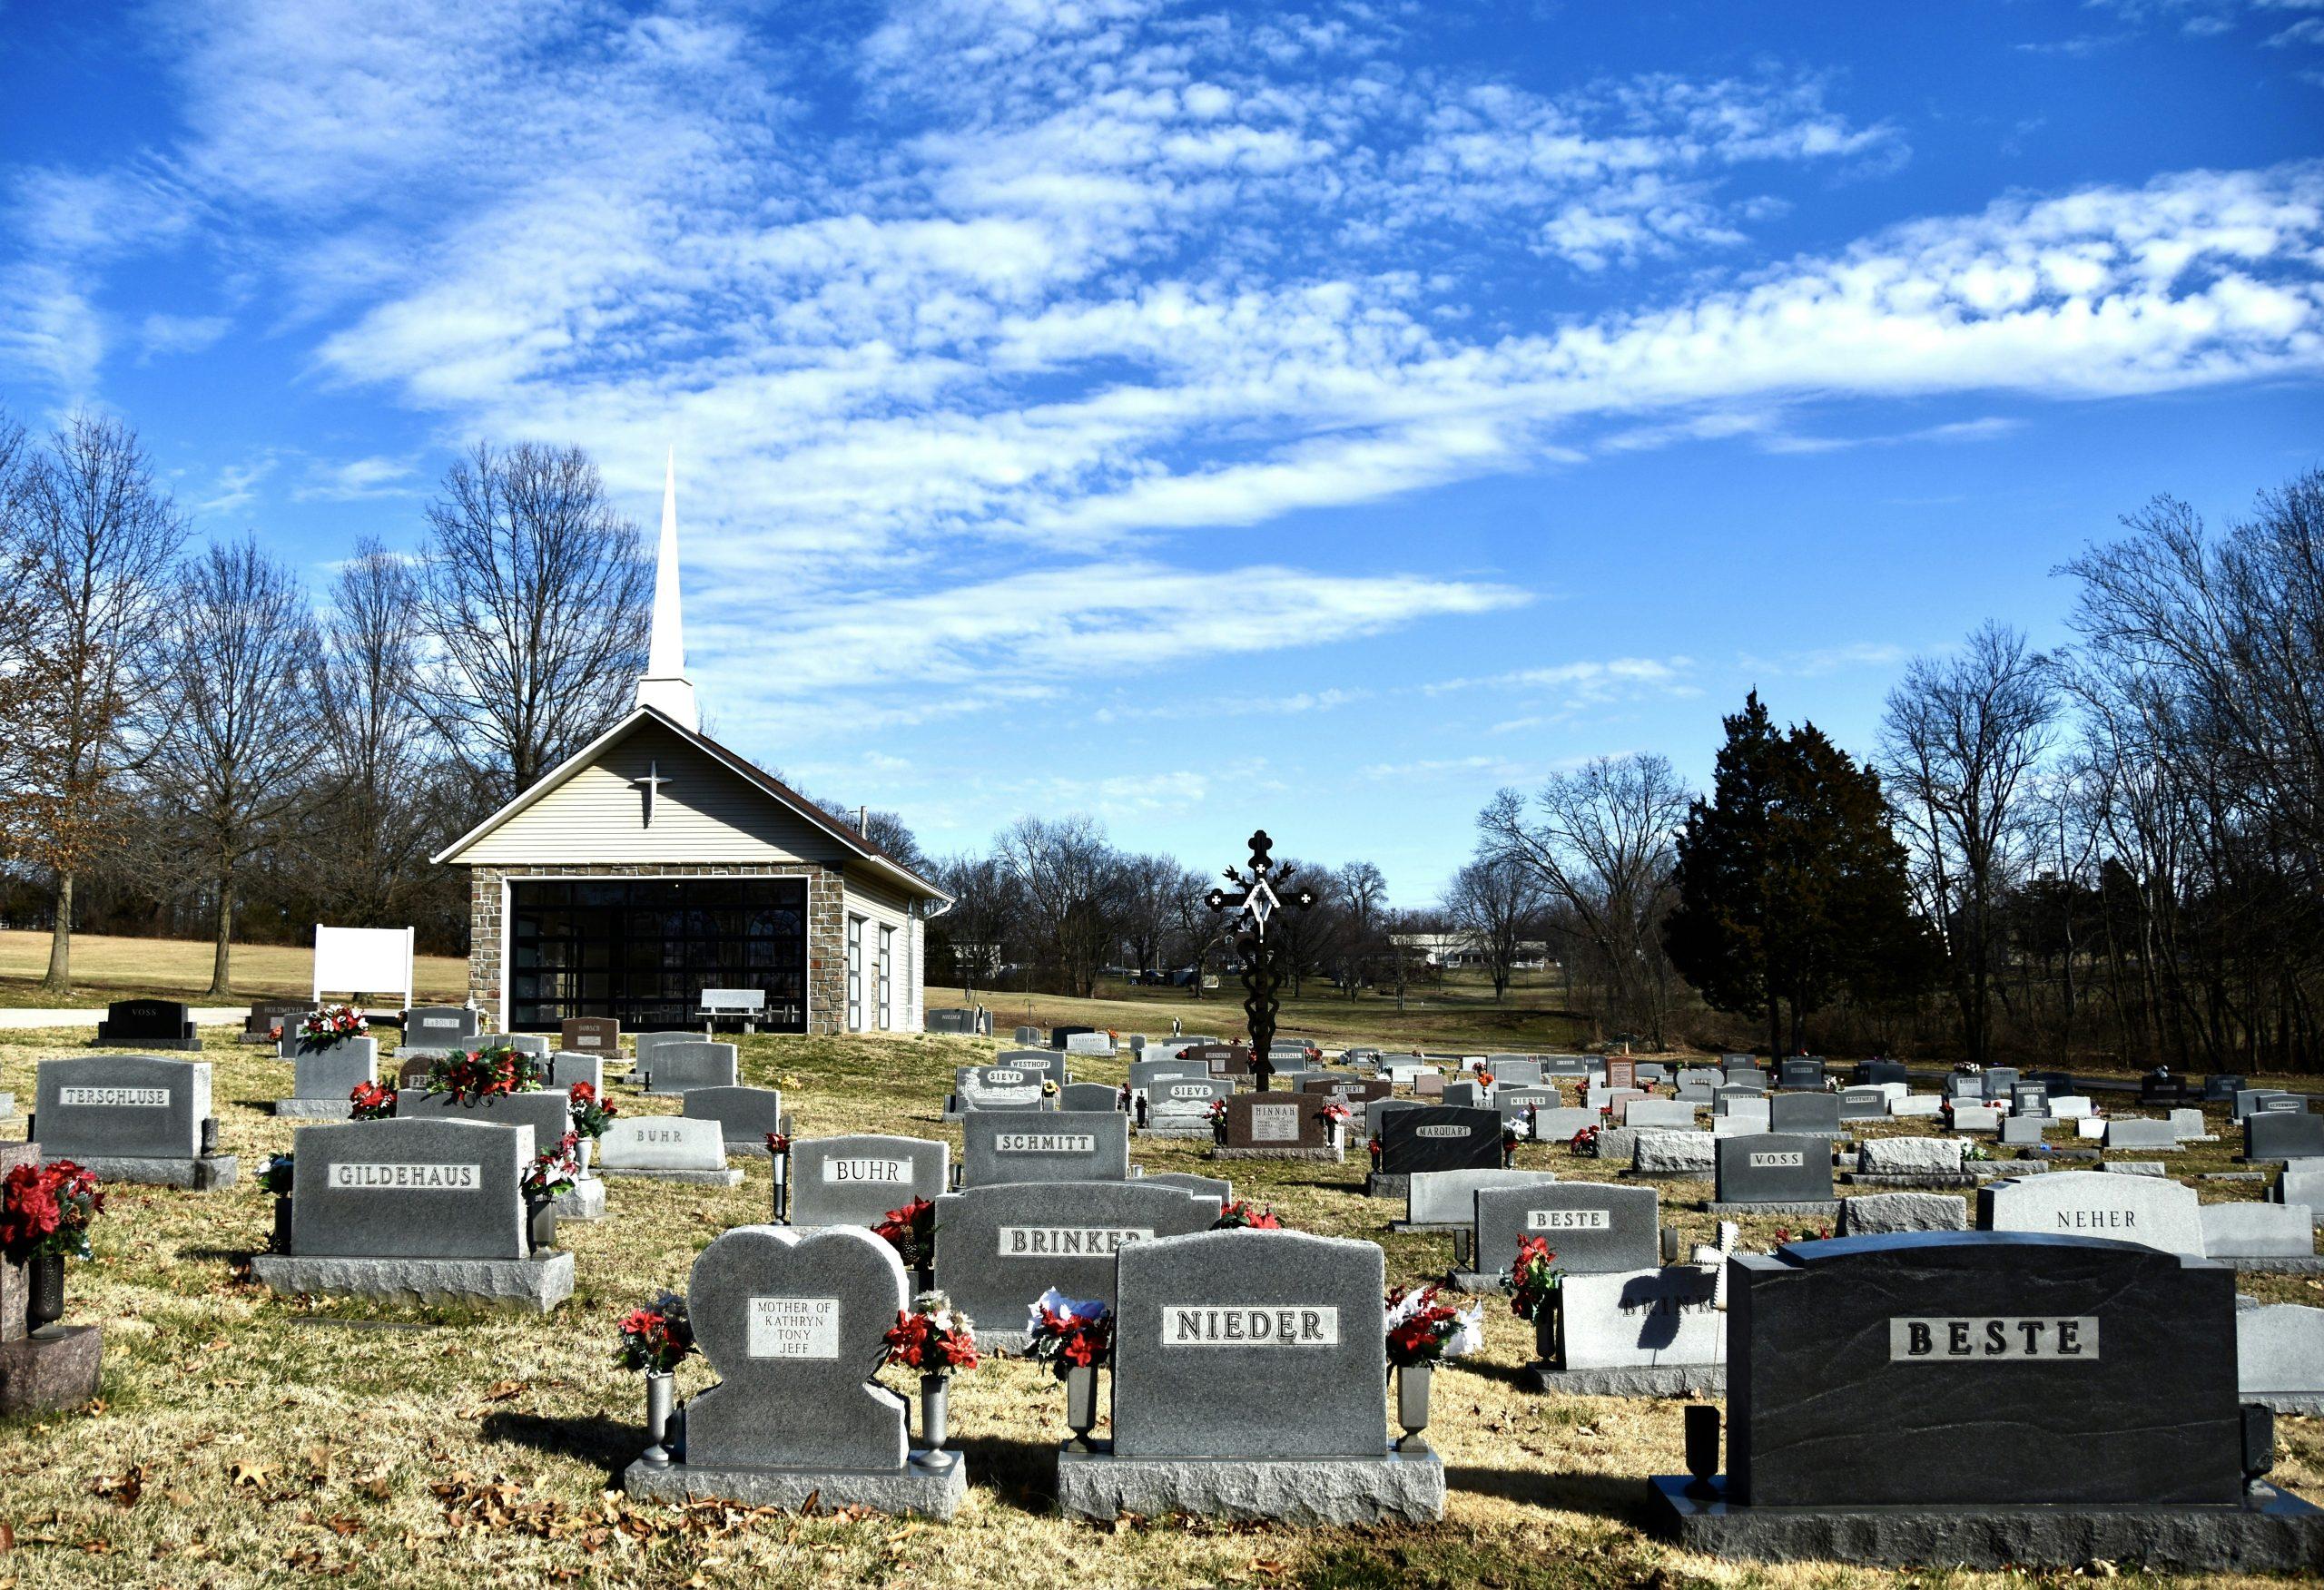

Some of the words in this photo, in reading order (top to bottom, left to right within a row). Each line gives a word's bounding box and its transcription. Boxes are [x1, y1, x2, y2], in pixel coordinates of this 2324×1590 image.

[132, 1008, 157, 1016] VOSS
[1012, 1060, 1049, 1068] WESTHOFF
[990, 1073, 1021, 1081] SIEVE
[1174, 1086, 1209, 1095] SIEVE
[1337, 1086, 1362, 1094] ELBERT
[66, 1089, 165, 1104] TERSCHLUSE
[1512, 1097, 1545, 1105] NIEDER
[1256, 1107, 1295, 1115] HINNAH
[636, 1130, 683, 1142] BUHR
[1419, 1126, 1468, 1136] MARQUART
[1002, 1135, 1088, 1150] SCHMITT
[1755, 1153, 1798, 1165] VOSS
[338, 1165, 473, 1187] GILDEHAUS
[836, 1161, 900, 1182] BUHR
[1536, 1212, 1601, 1228] BESTE
[2057, 1211, 2136, 1228] NEHER
[757, 1301, 808, 1313] MOTHER
[816, 1302, 831, 1313] OF
[765, 1315, 824, 1327] KATHRYN
[1177, 1310, 1324, 1340] NIEDER
[777, 1329, 812, 1340] TONY
[1907, 1320, 2083, 1356] BESTE
[779, 1343, 809, 1354] JEFF
